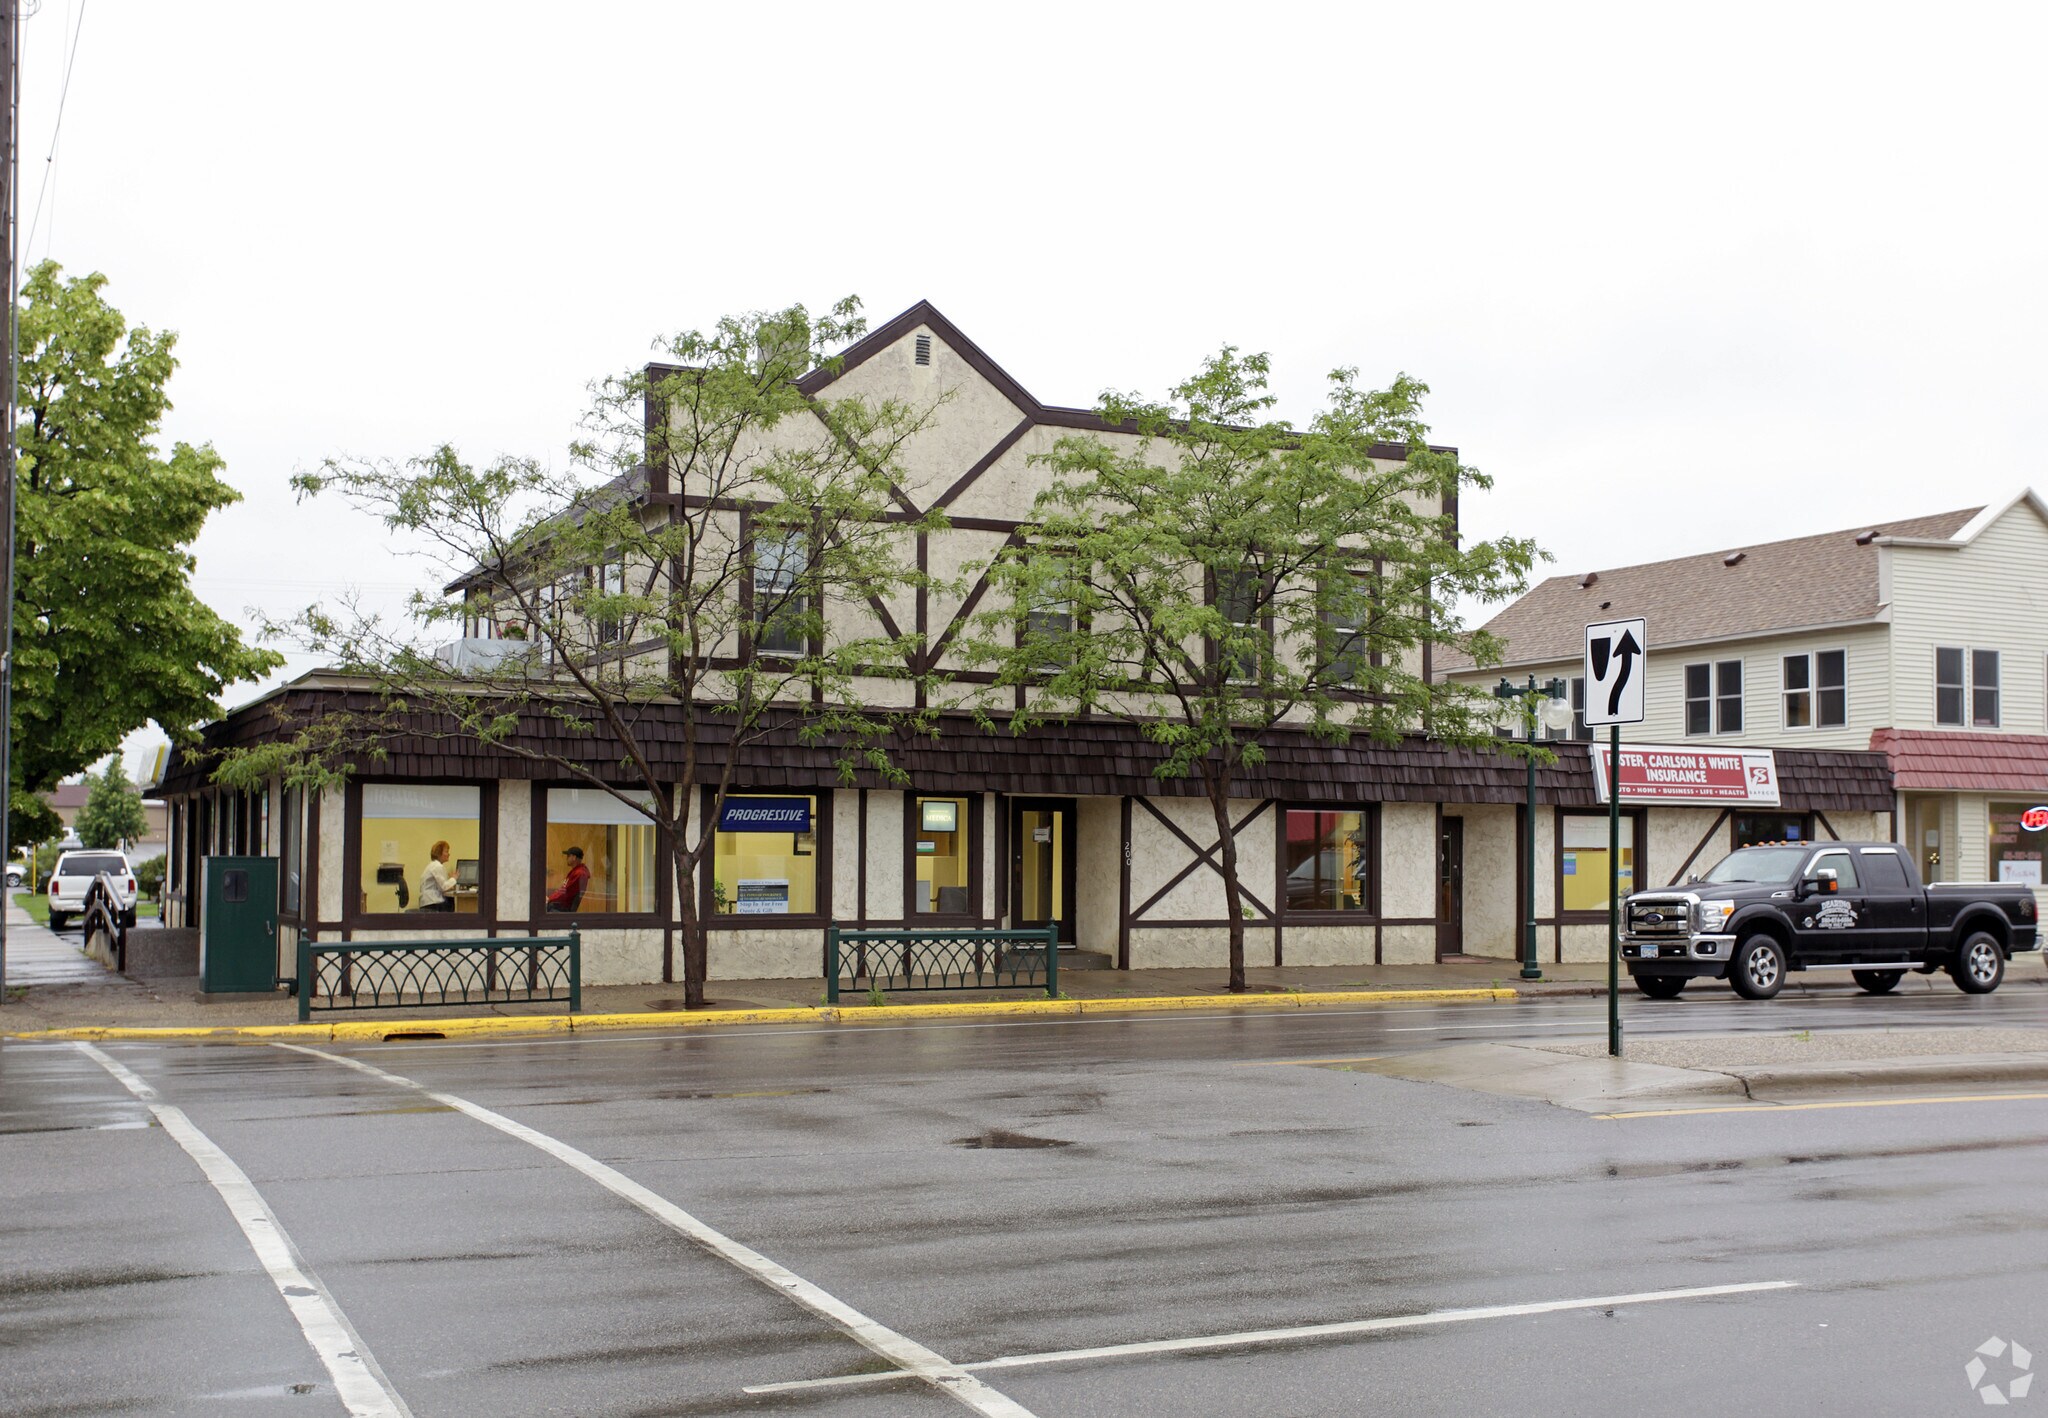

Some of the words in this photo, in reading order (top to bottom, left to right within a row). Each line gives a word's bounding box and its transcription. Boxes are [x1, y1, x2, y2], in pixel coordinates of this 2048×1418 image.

[1606, 753, 1648, 769] FSTER,
[1648, 754, 1697, 769] CARLSON
[1698, 756, 1707, 769] &
[1708, 756, 1741, 770] WHITE
[1646, 769, 1707, 783] INSURANCE
[1663, 787, 1694, 795] BUSINESS
[726, 809, 805, 821] PROGRESSIVE
